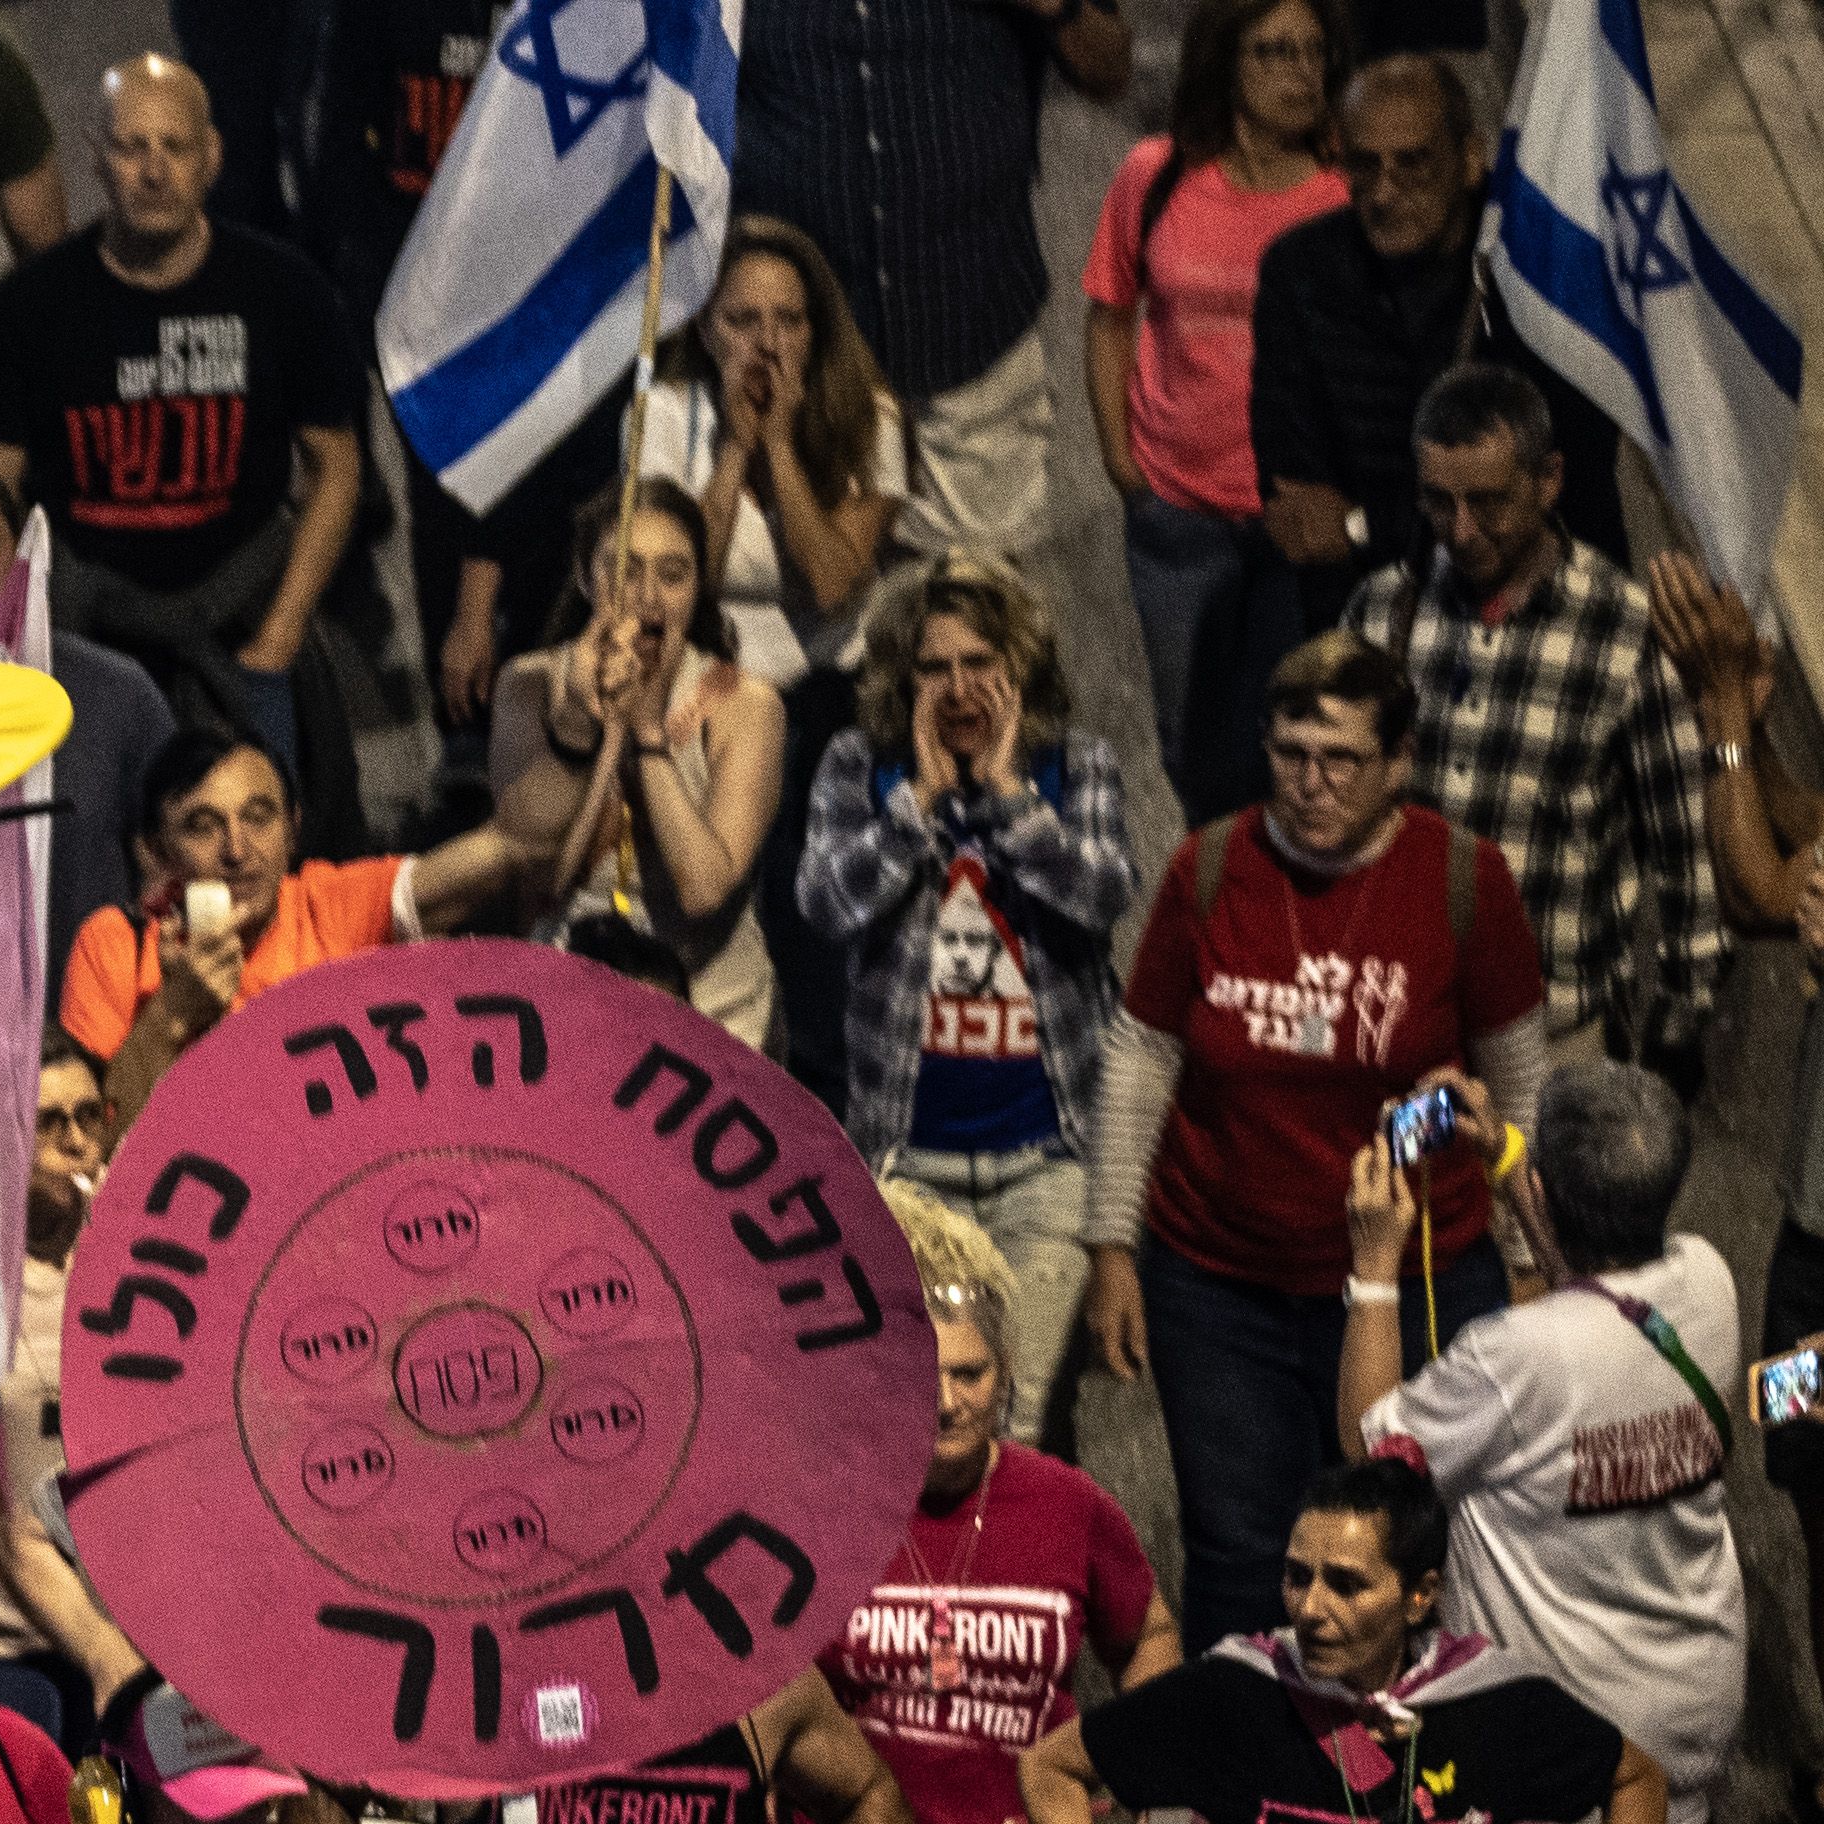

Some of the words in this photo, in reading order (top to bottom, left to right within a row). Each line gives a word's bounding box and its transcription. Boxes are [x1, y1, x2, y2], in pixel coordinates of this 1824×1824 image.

[284, 993, 549, 1118] הזה
[79, 1151, 252, 1386] כולו
[611, 1038, 882, 1353] הפסח
[316, 1510, 818, 1745] מרור
[847, 1605, 1047, 1663] PINKRONT
